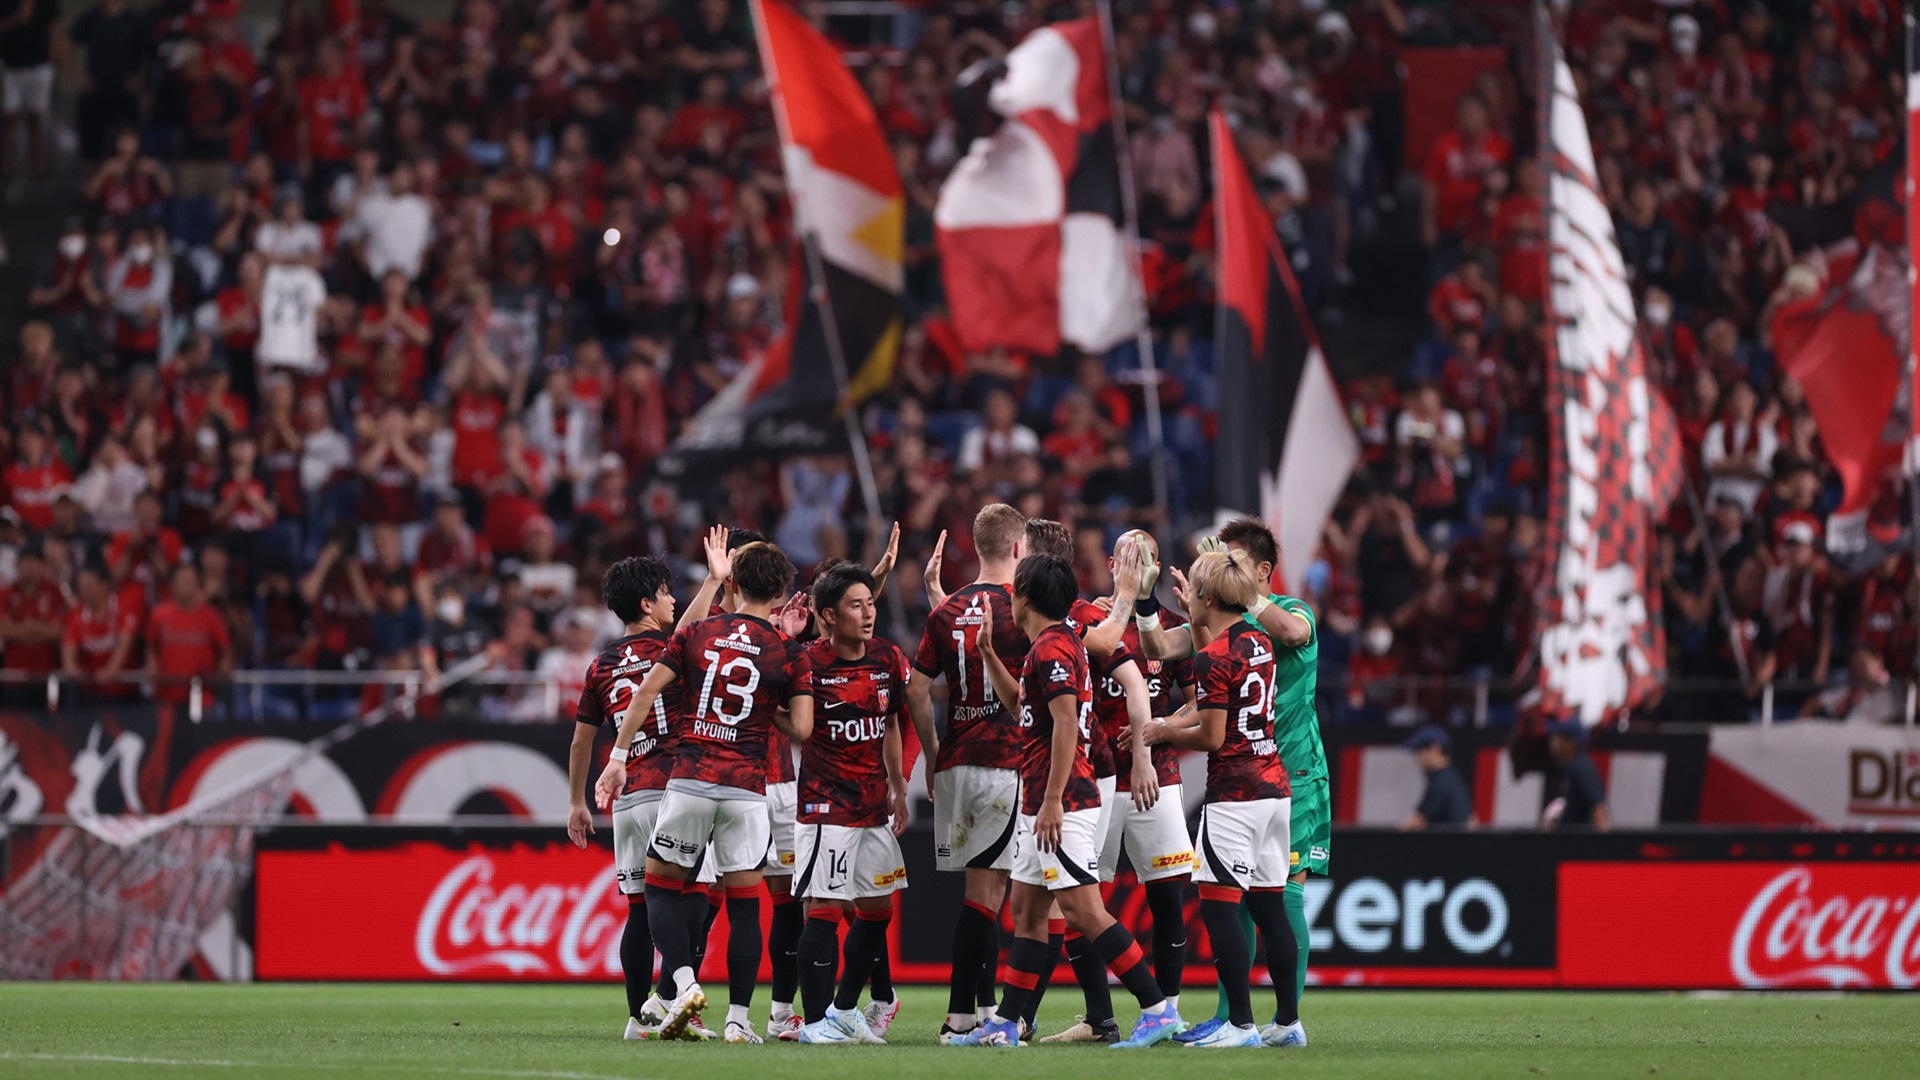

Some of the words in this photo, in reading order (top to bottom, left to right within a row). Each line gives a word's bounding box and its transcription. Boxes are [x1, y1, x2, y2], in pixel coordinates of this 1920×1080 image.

[697, 649, 760, 726] 13
[821, 676, 848, 685] EneCle
[694, 719, 737, 742] RYOMA
[656, 833, 699, 848] DELICA
[828, 849, 847, 880] 14
[1158, 853, 1193, 867] DHL
